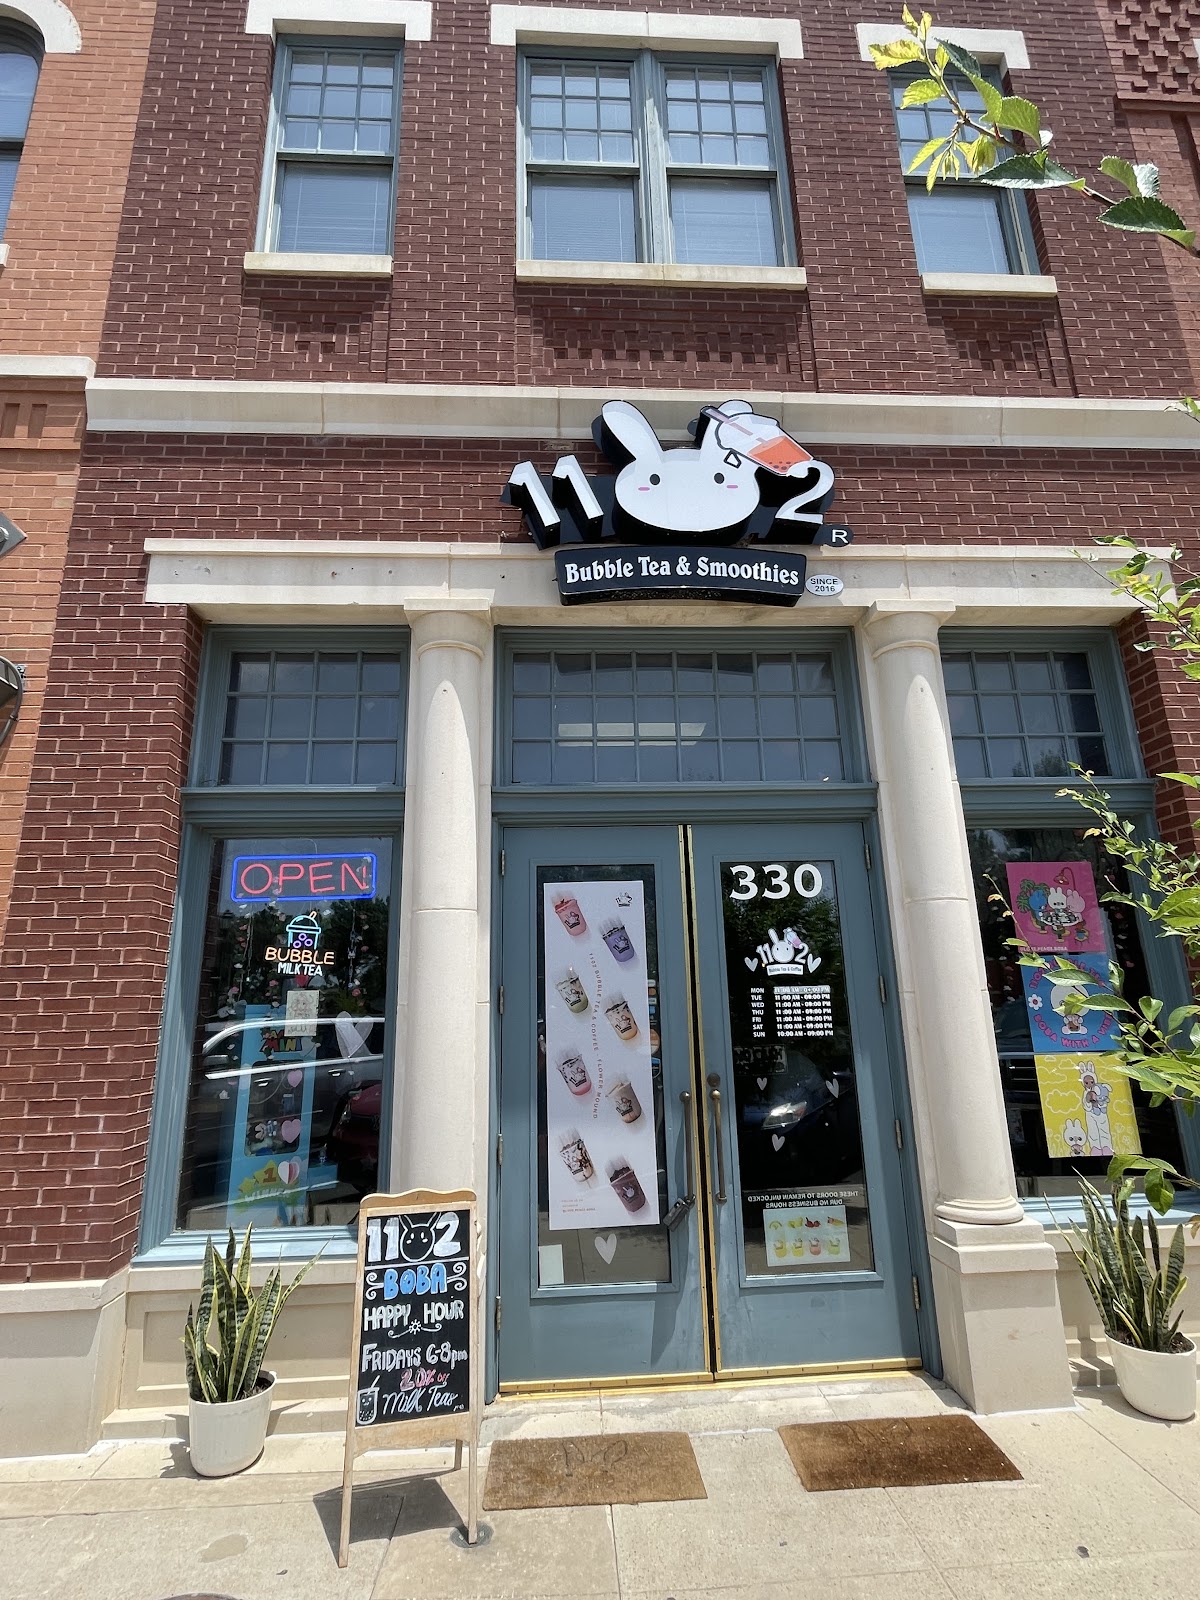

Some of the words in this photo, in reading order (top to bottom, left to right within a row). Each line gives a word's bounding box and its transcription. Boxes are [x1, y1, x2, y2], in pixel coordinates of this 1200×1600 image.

[565, 559, 634, 583] Bubble
[637, 556, 672, 577] Tea
[676, 556, 692, 576] &
[697, 557, 799, 585] Smoothies
[240, 862, 369, 894] OPEN
[729, 864, 823, 900] 330
[264, 946, 335, 965] BUBBLE
[277, 962, 300, 975] MILK
[303, 964, 323, 976] TEA
[1034, 1013, 1058, 1042] BOBA
[1061, 1037, 1089, 1048] WITH
[1091, 1034, 1100, 1044] A
[383, 1262, 448, 1300] BOBA
[363, 1303, 411, 1331] HAPPY
[423, 1300, 464, 1324] HOUR
[361, 1343, 422, 1372] FRIDAYS
[425, 1341, 468, 1369] 6-8pm
[400, 1367, 436, 1392] 20%
